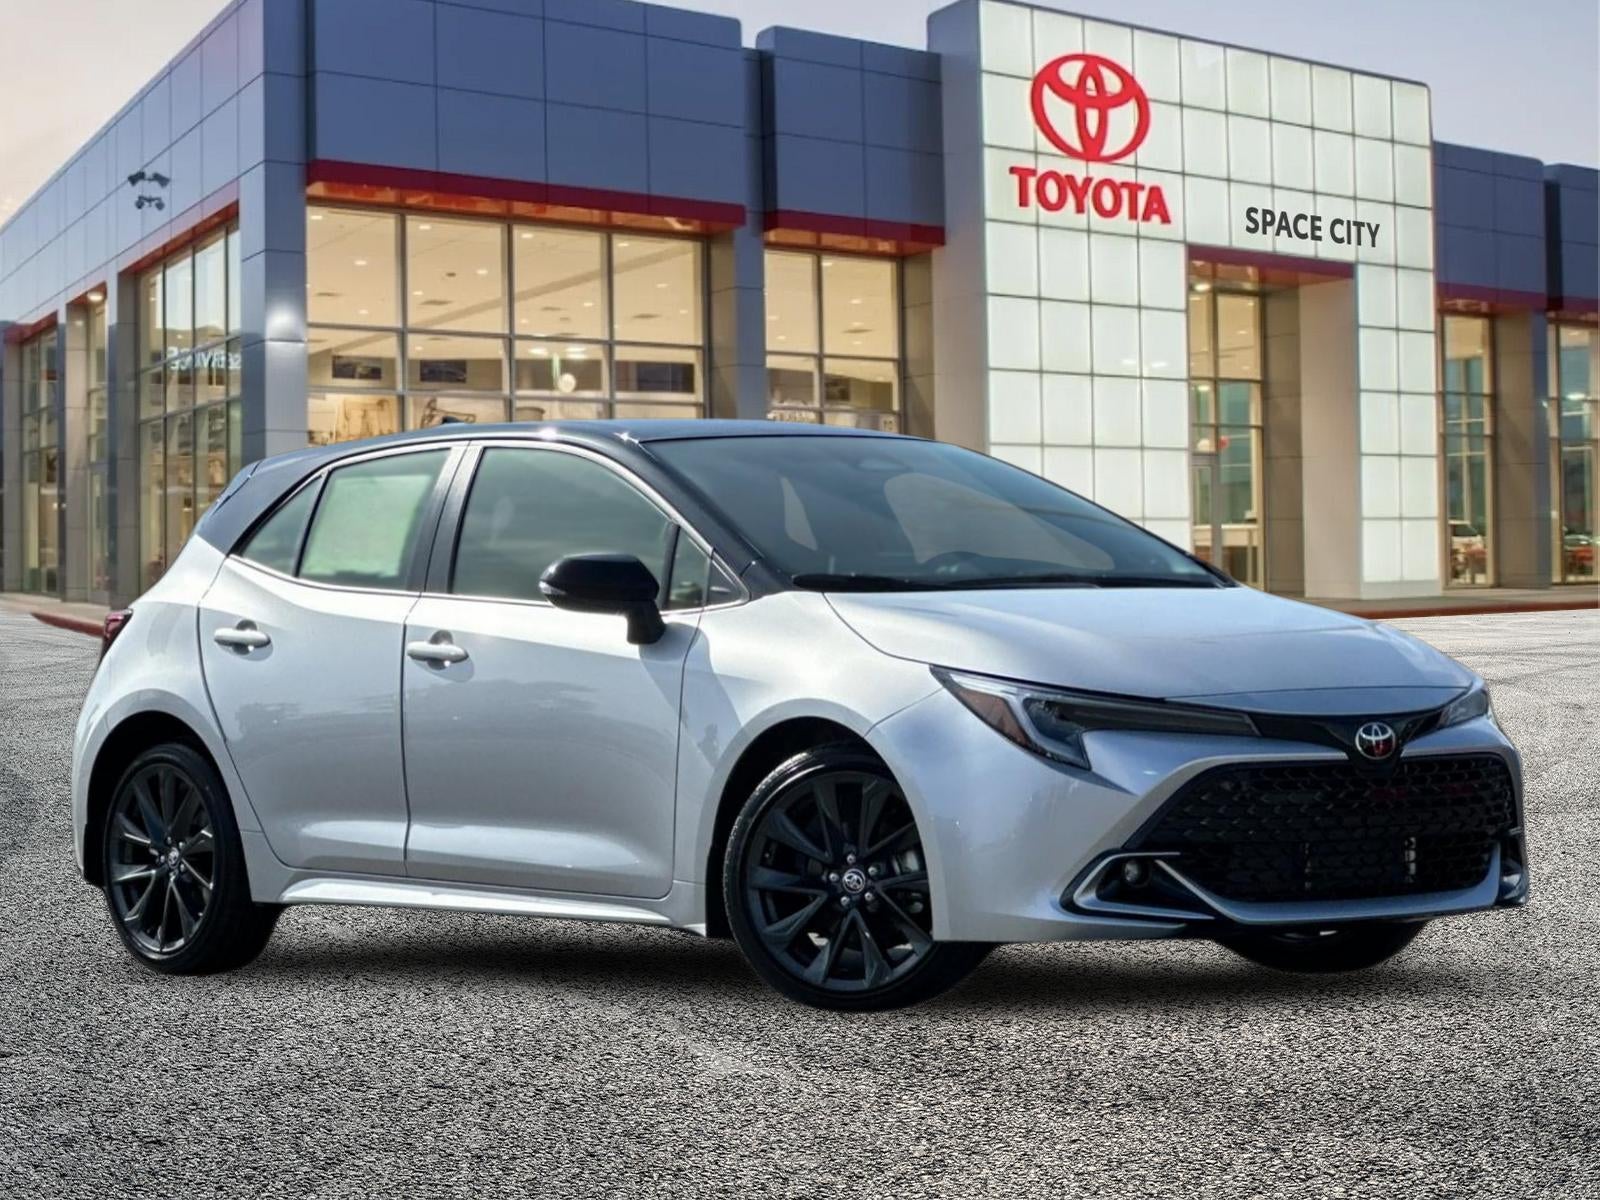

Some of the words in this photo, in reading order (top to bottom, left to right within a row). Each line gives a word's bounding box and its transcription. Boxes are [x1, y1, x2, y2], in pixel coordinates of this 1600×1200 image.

[1009, 166, 1171, 225] TOYOTA
[1246, 207, 1322, 241] SPACE
[1330, 218, 1380, 247] CITY
